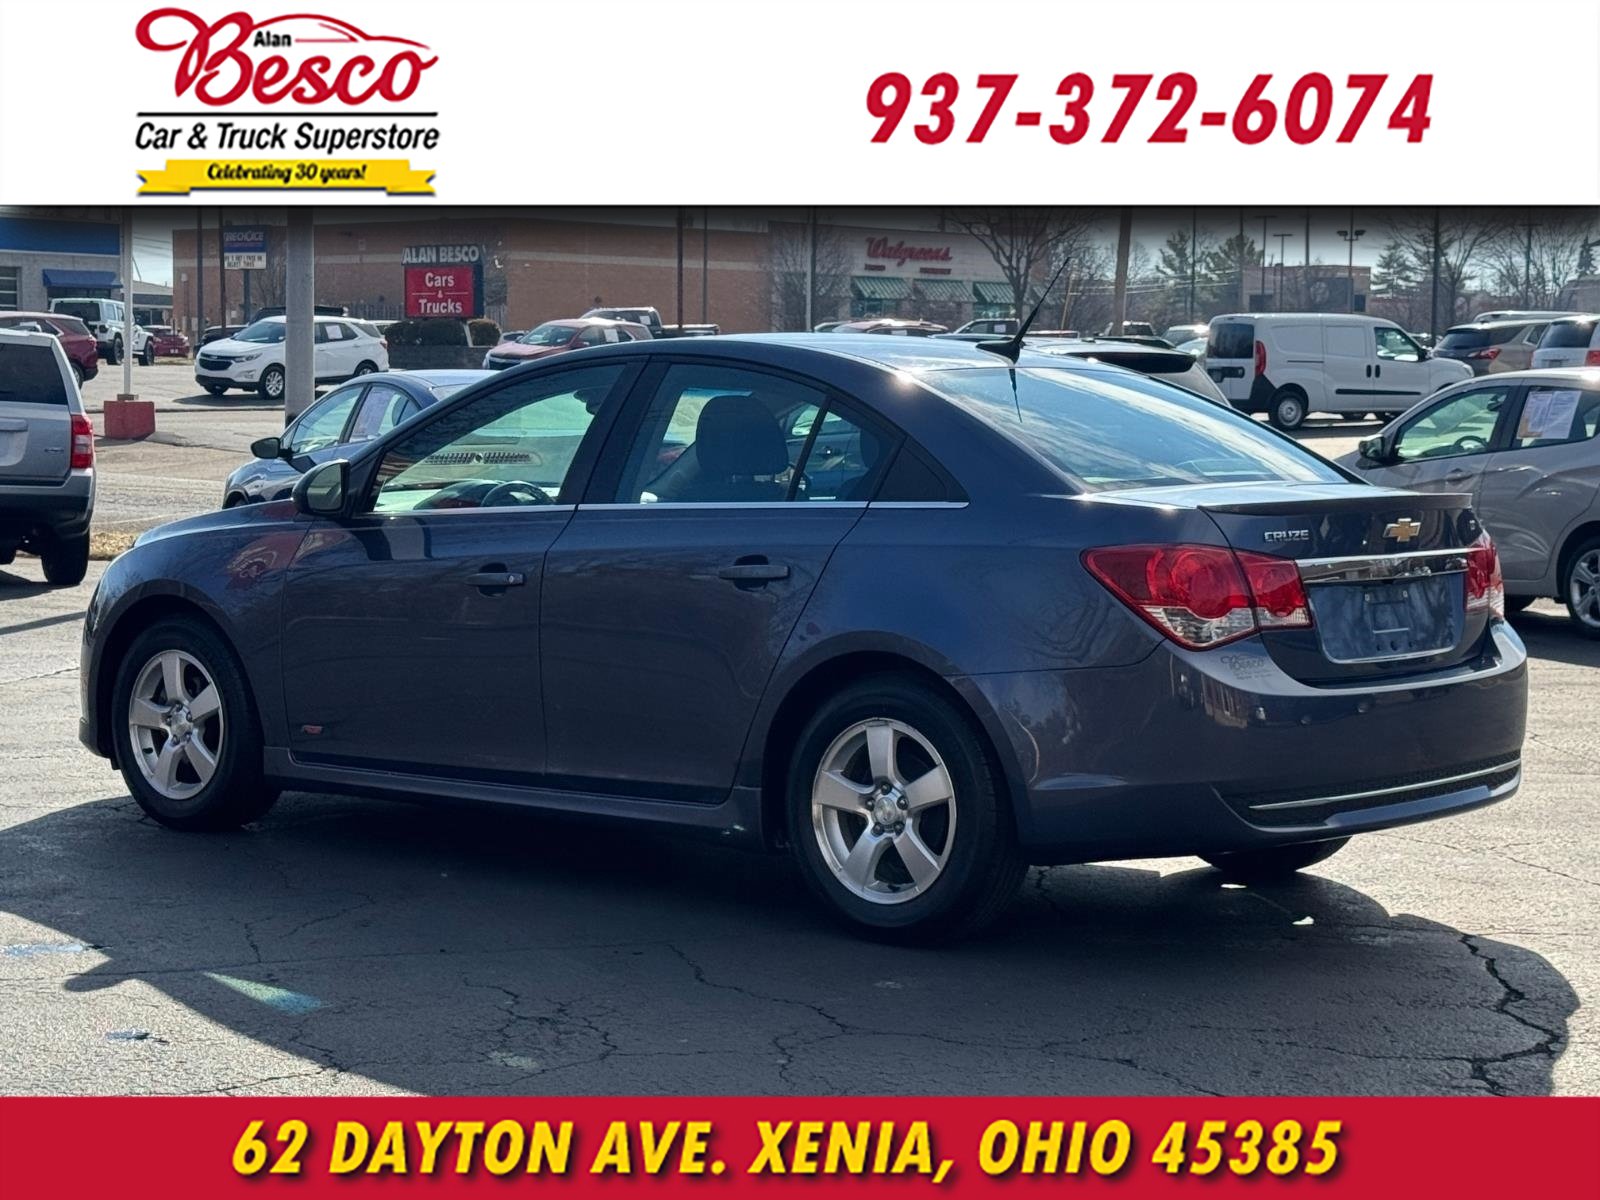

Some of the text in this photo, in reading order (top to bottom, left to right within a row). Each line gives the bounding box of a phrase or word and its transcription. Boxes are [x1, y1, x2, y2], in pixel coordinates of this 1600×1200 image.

[402, 245, 479, 264] ALAN BESCO
[865, 236, 953, 267] Walgreens
[425, 272, 455, 288] Cars
[418, 298, 463, 315] Trucks
[1263, 529, 1310, 542] CRUZE
